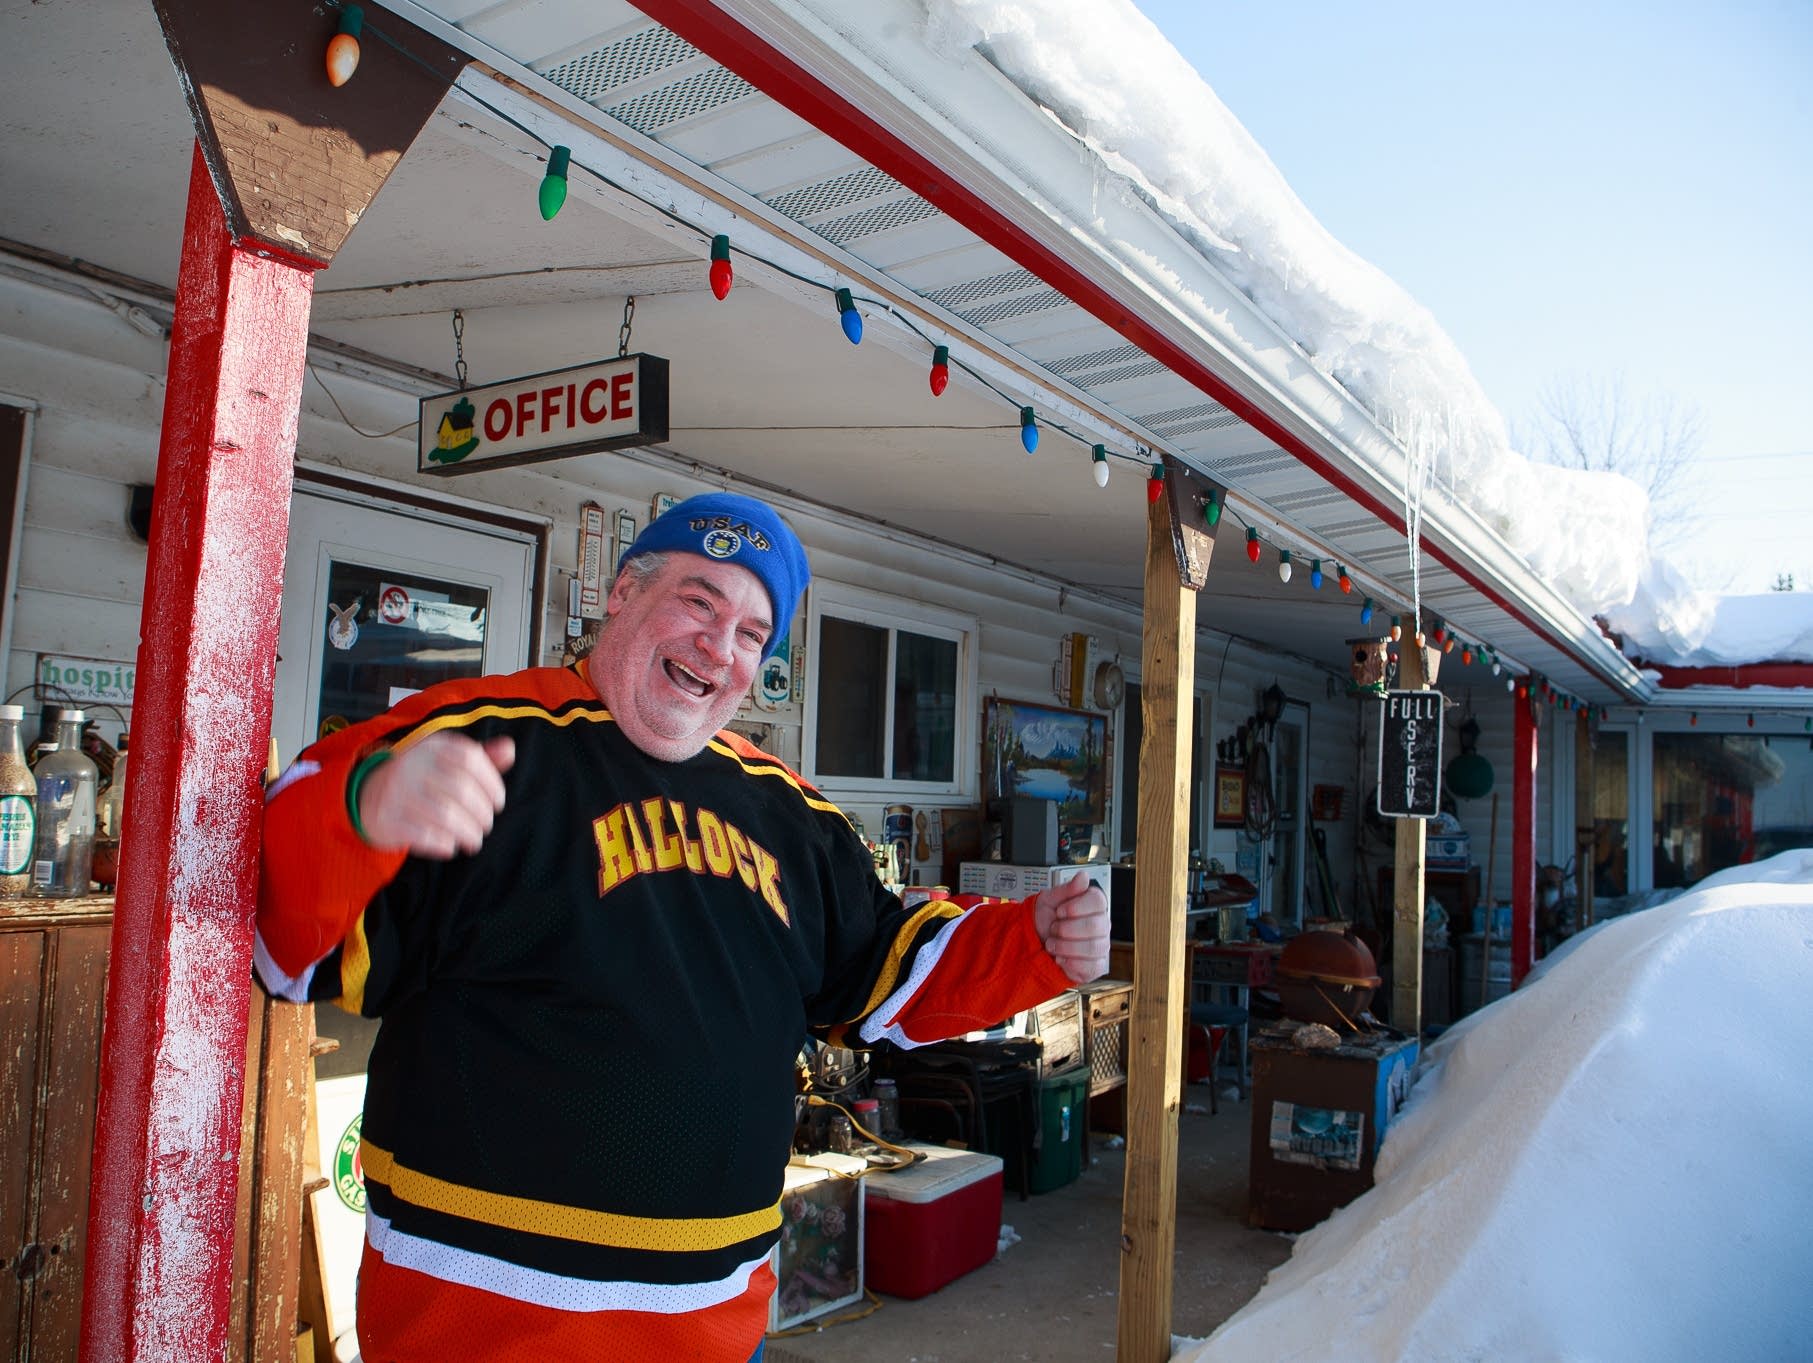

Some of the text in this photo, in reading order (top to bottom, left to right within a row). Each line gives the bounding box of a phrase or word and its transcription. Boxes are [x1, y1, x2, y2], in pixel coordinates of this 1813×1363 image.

[484, 372, 634, 442] OFFICE
[688, 516, 770, 552] USAF
[1390, 698, 1433, 720] FULL
[1406, 719, 1417, 809] SERV
[592, 795, 791, 929] HILLOCK
